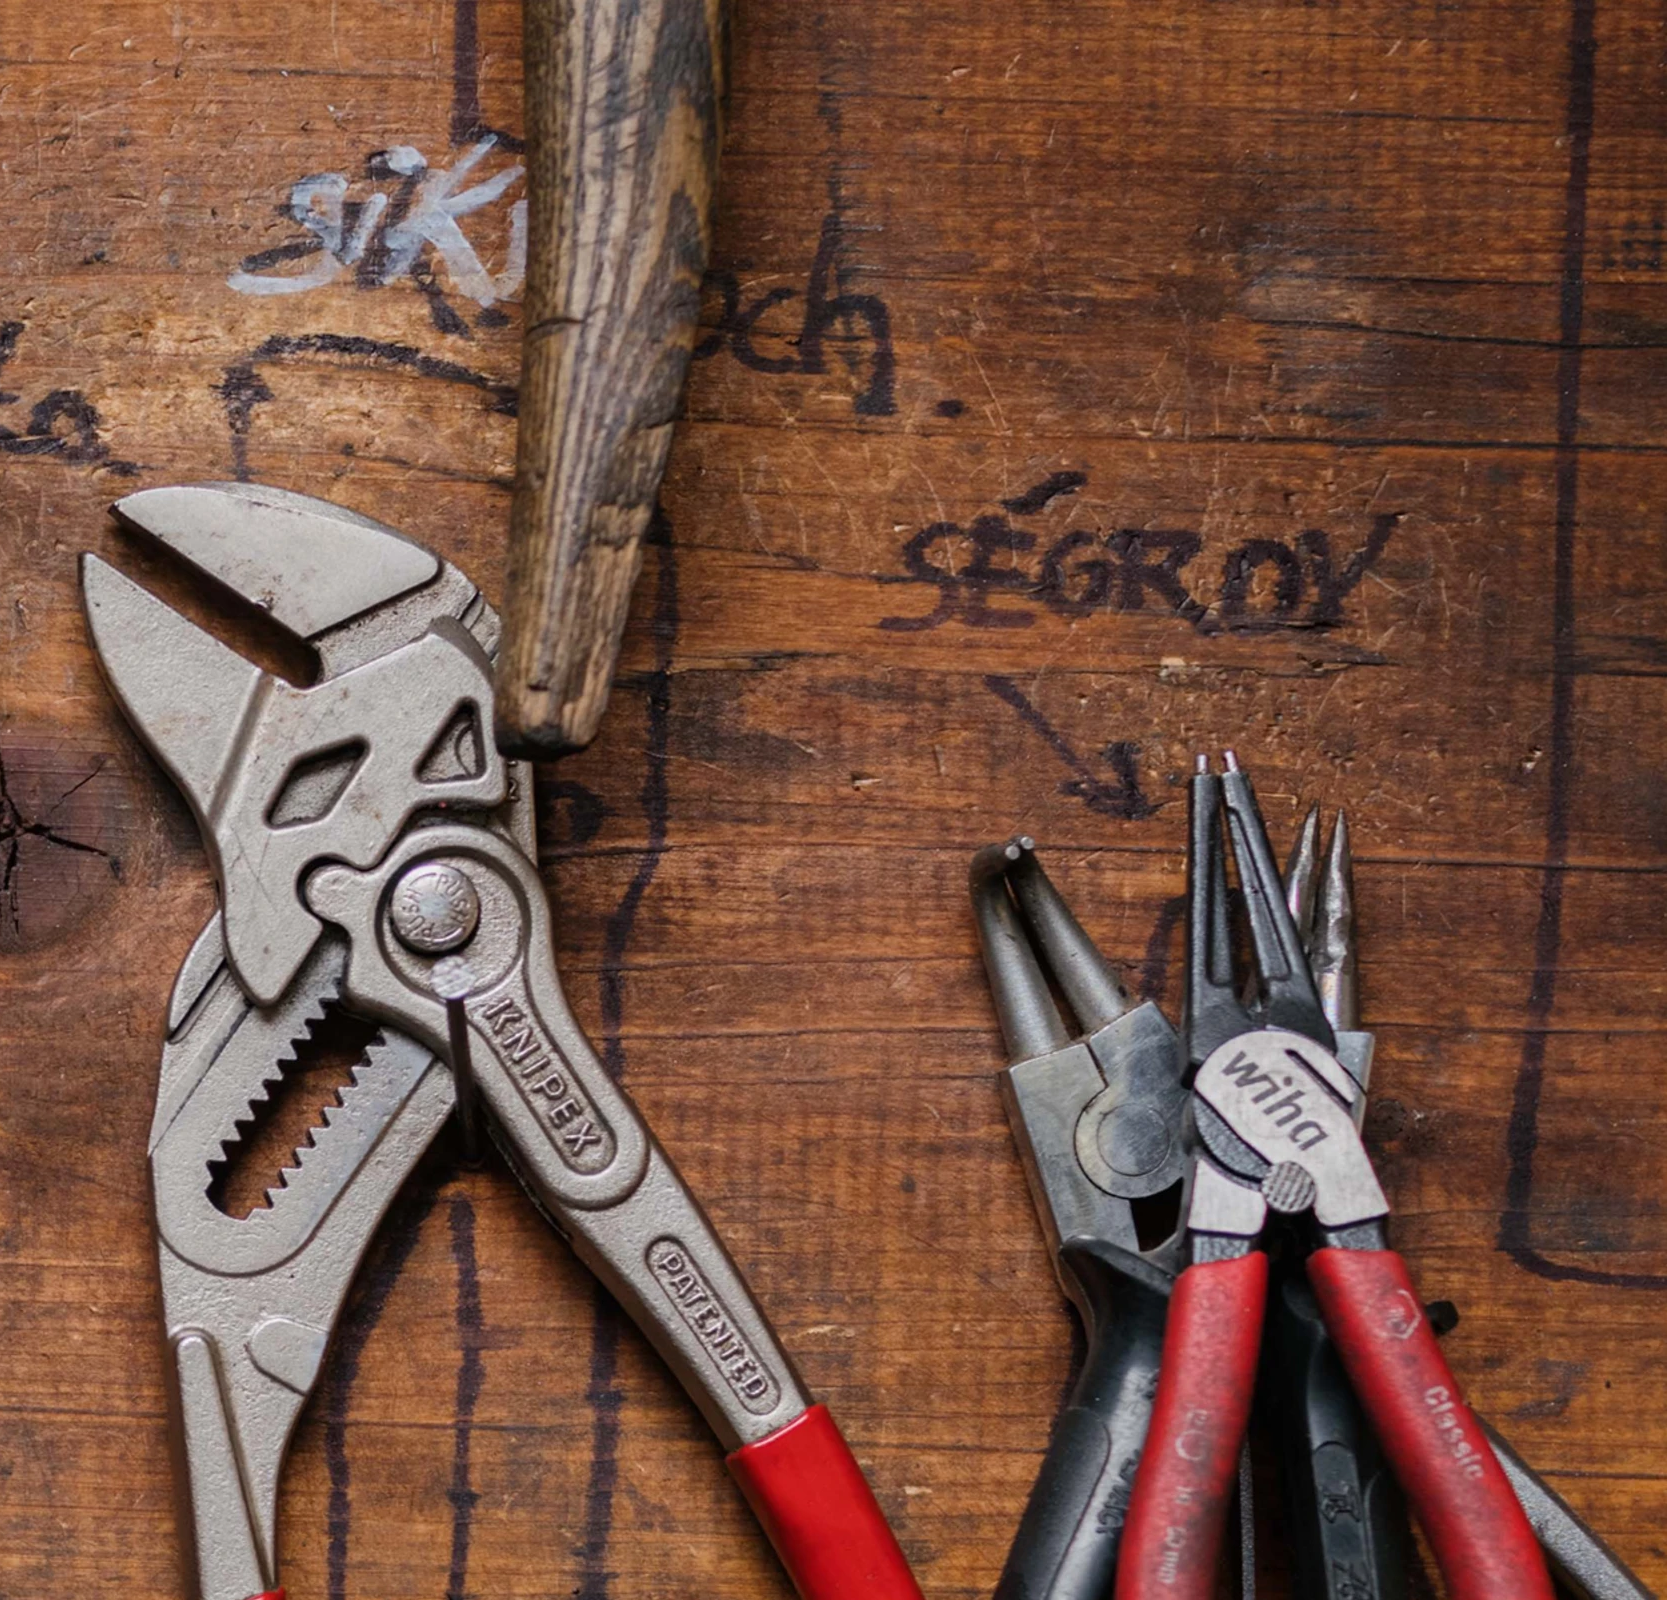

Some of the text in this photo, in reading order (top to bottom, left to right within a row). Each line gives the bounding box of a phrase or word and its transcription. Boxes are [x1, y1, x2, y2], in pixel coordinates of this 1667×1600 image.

[482, 998, 606, 1157] KNIPEX
[1221, 1050, 1329, 1152] wiha
[657, 1252, 772, 1403] PATENTED
[1424, 1385, 1485, 1480] Classic
